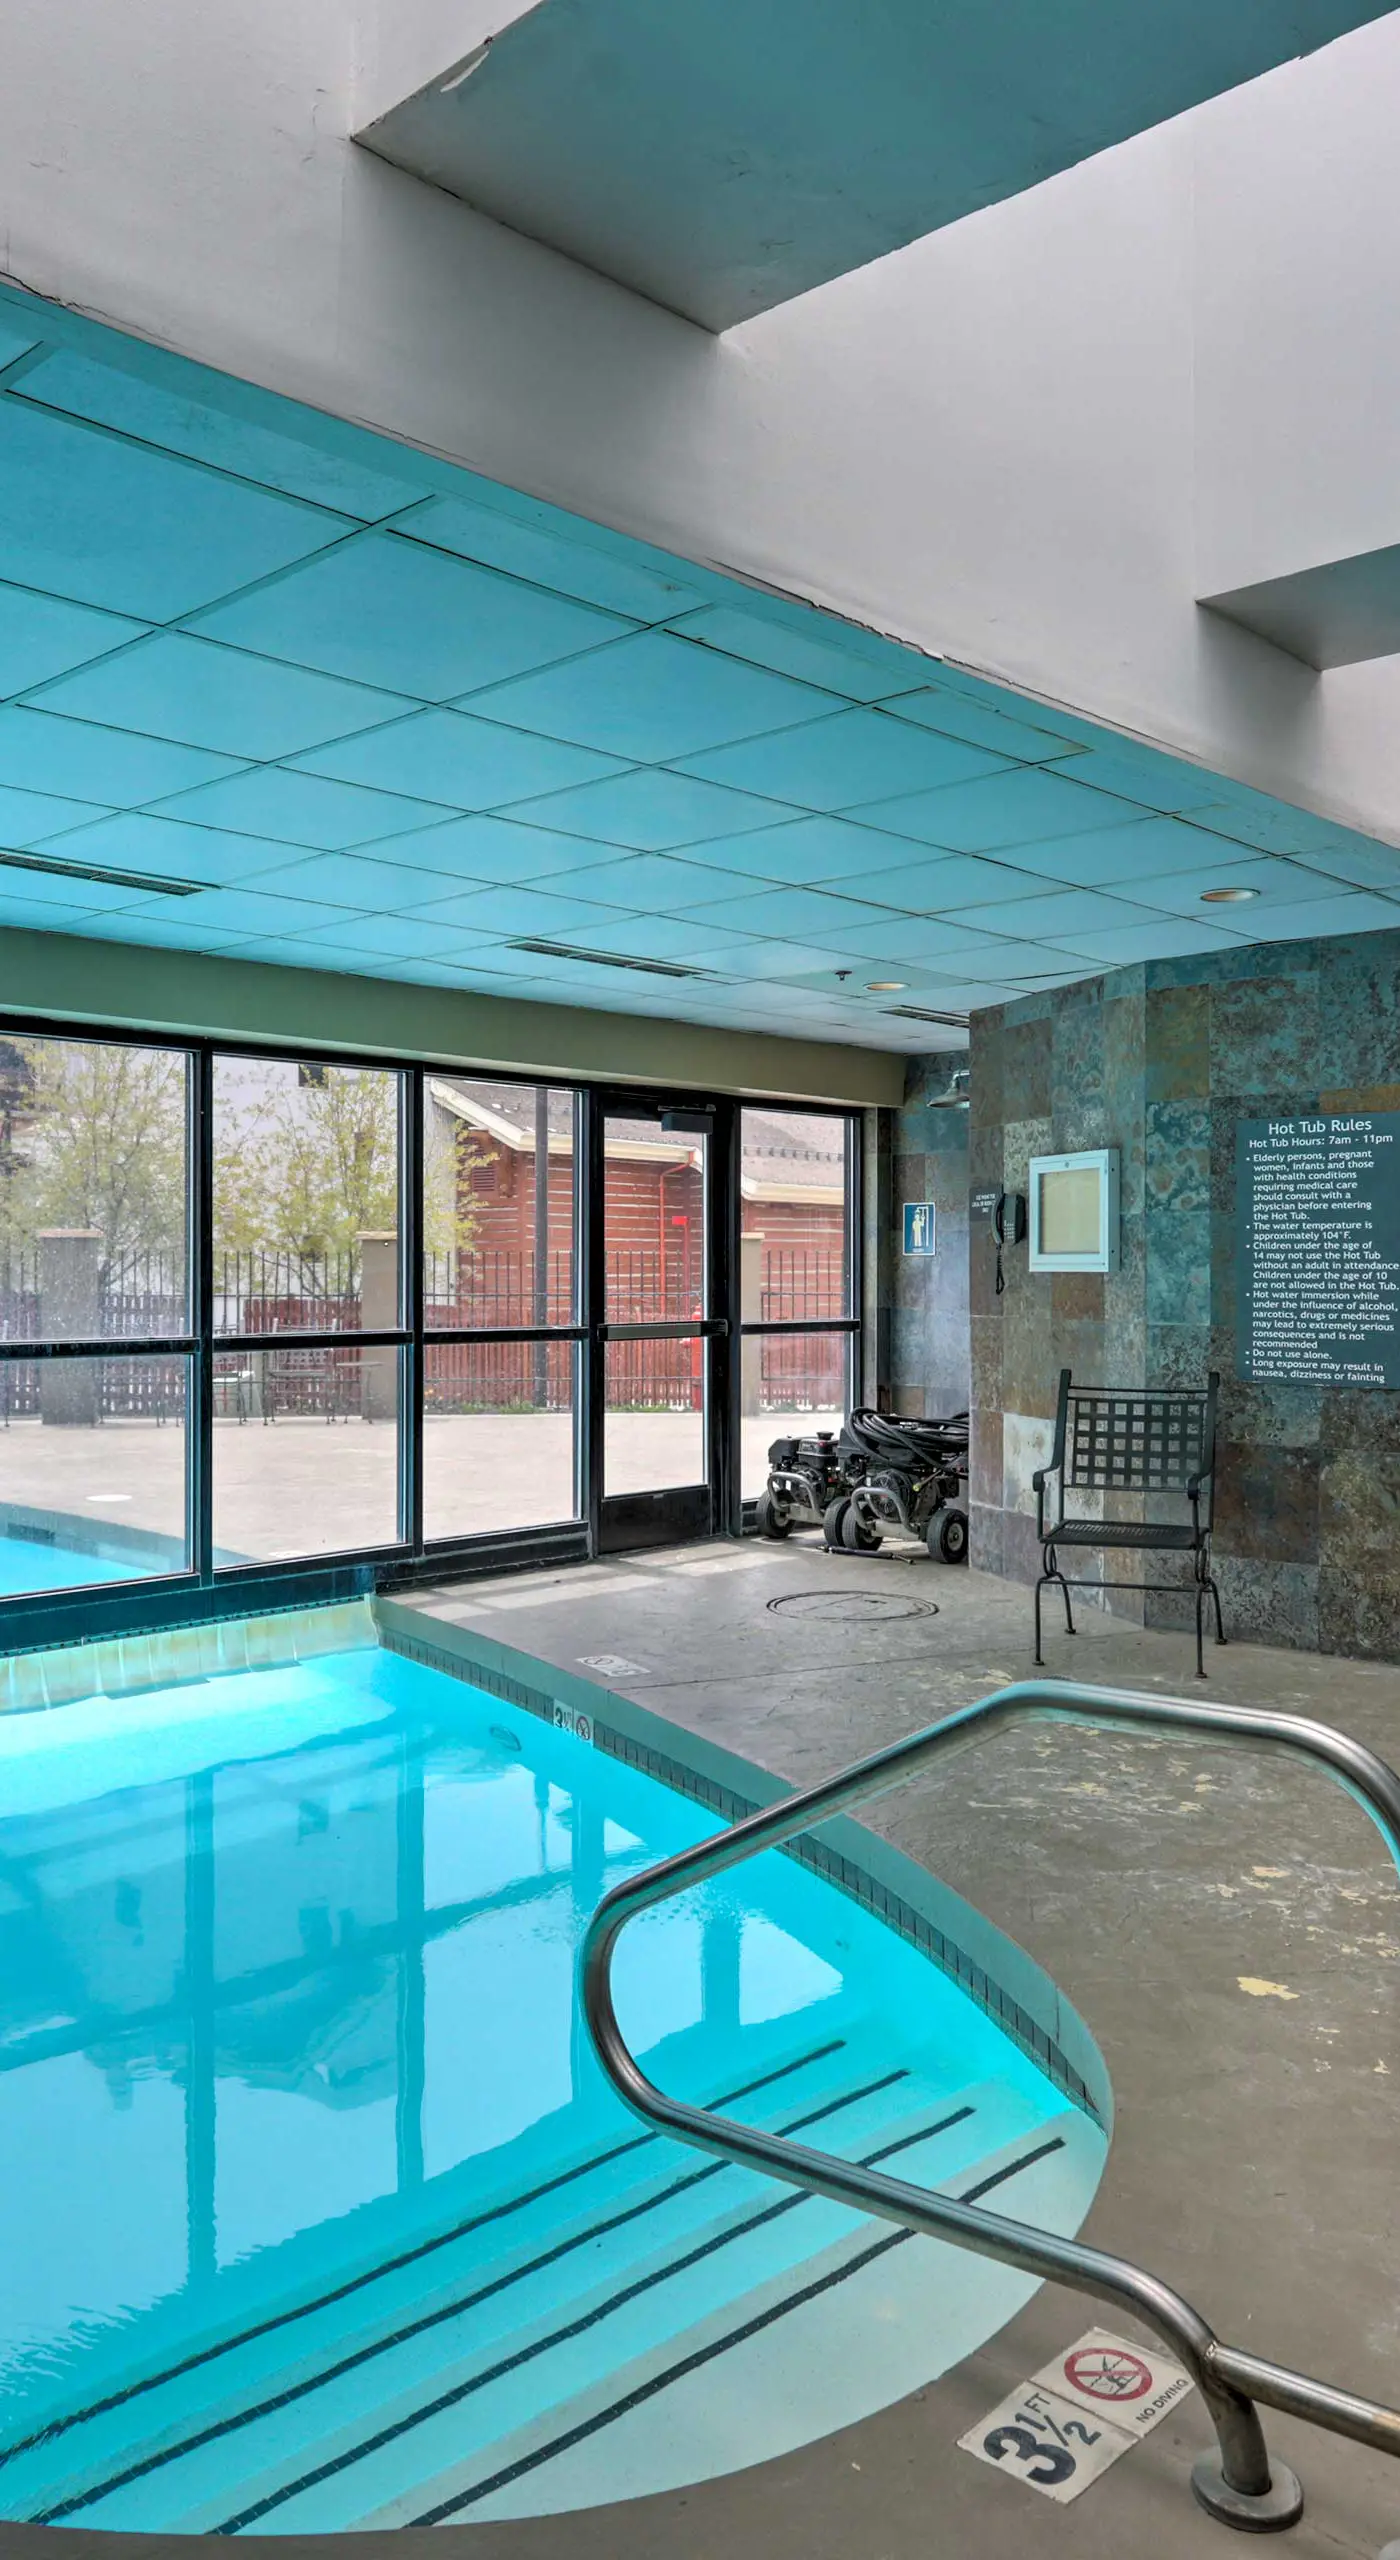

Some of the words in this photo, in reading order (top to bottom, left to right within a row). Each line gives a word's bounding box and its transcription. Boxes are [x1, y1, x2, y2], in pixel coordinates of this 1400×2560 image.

[1269, 1123, 1295, 1135] Hot
[1299, 1121, 1325, 1133] Tub
[1332, 1119, 1372, 1131] Rules
[1250, 1140, 1267, 1148] Hot
[1270, 1139, 1288, 1147] Tub
[1292, 1138, 1324, 1146] Hours:
[1329, 1136, 1351, 1144] 7am
[1364, 1135, 1393, 1145] 11pm
[1254, 1154, 1285, 1163] Elderly
[1287, 1153, 1325, 1161] persons,
[1329, 1151, 1372, 1160] pregnant
[1254, 1164, 1289, 1172] women,
[1293, 1162, 1324, 1170] infants
[1254, 1184, 1294, 1192] requiring
[1254, 1193, 1283, 1201] should
[1285, 1192, 1318, 1200] consult
[1254, 1203, 1295, 1211] physician
[1332, 1202, 1371, 1210] entering
[1302, 1222, 1361, 1230] temperature
[1254, 1232, 1319, 1241] approximately
[1253, 1242, 1291, 1250] Children
[1363, 1241, 1372, 1249] of
[1253, 1271, 1291, 1279] Children
[1343, 1273, 1359, 1281] age
[1376, 1272, 1387, 1280] 10
[1378, 1282, 1399, 1290] Tub.
[1353, 1292, 1379, 1300] while
[1359, 1302, 1398, 1312] alcohol,
[1300, 1312, 1325, 1320] drugs
[1309, 1322, 1357, 1331] extremely
[1360, 1323, 1394, 1331] serious
[1253, 1331, 1315, 1339] consequences
[1253, 1360, 1274, 1368] Long
[1276, 1361, 1317, 1369] exposure
[1321, 1363, 1340, 1372] may
[1343, 1363, 1371, 1371] result
[1374, 1364, 1383, 1372] in
[1253, 1370, 1287, 1378] nausea,
[1290, 1371, 1331, 1380] dizziness
[1347, 1373, 1385, 1384] fainting
[1024, 2393, 1050, 2413] FT
[1136, 2407, 1155, 2423] NO
[1152, 2379, 1189, 2408] DIVING
